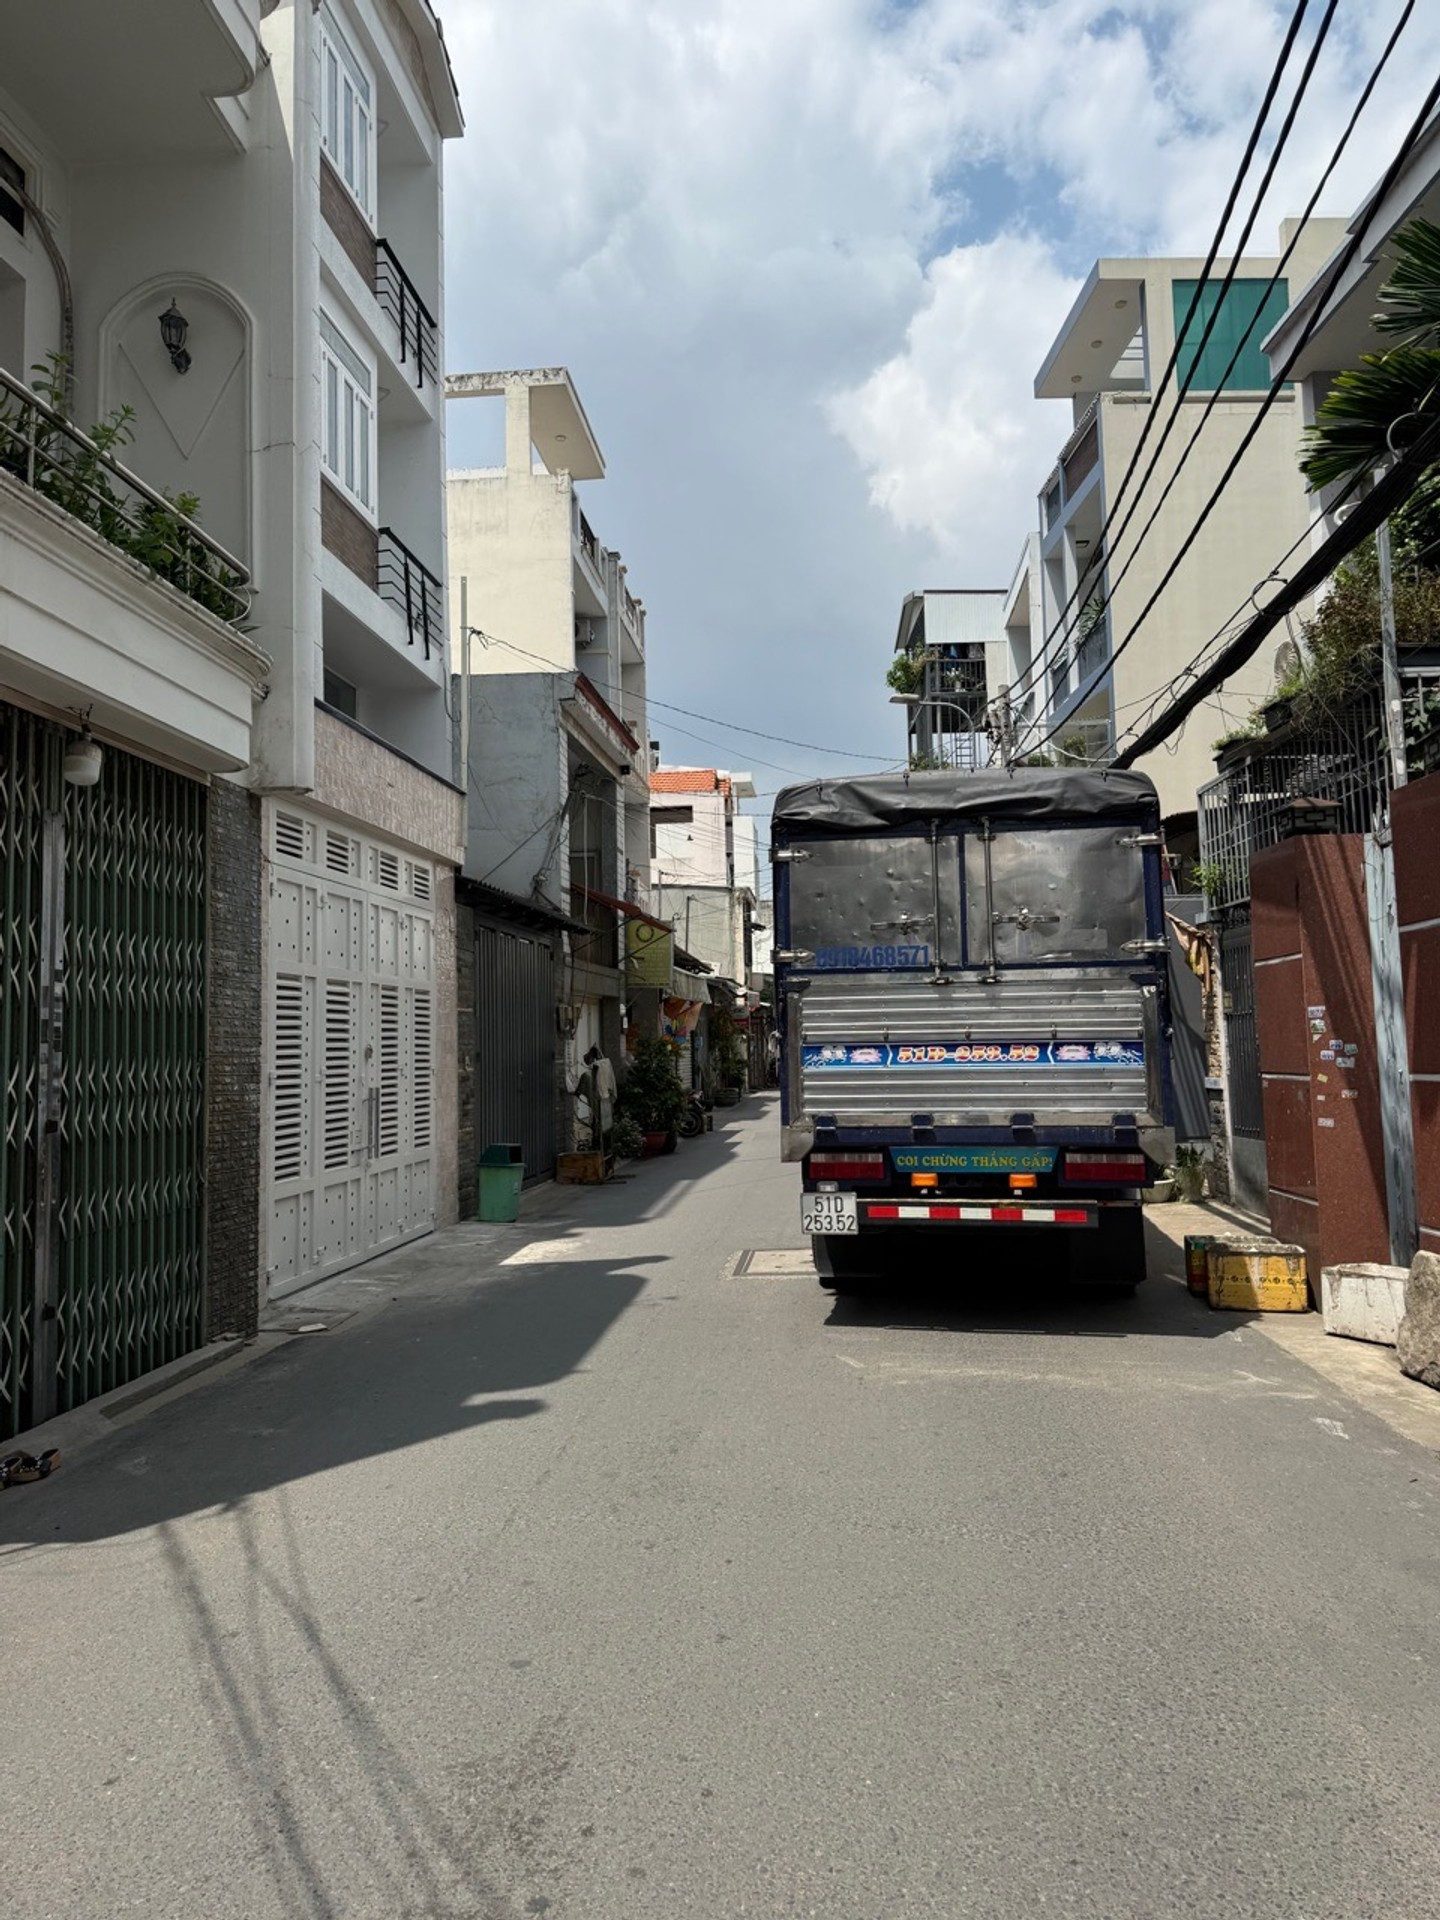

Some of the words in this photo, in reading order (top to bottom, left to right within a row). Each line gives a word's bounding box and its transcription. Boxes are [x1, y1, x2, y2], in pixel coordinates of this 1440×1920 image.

[898, 1045, 1039, 1062] 51D-253.52
[897, 1156, 918, 1167] COI
[814, 1195, 844, 1213] 51D
[804, 1214, 856, 1232] 253.52
